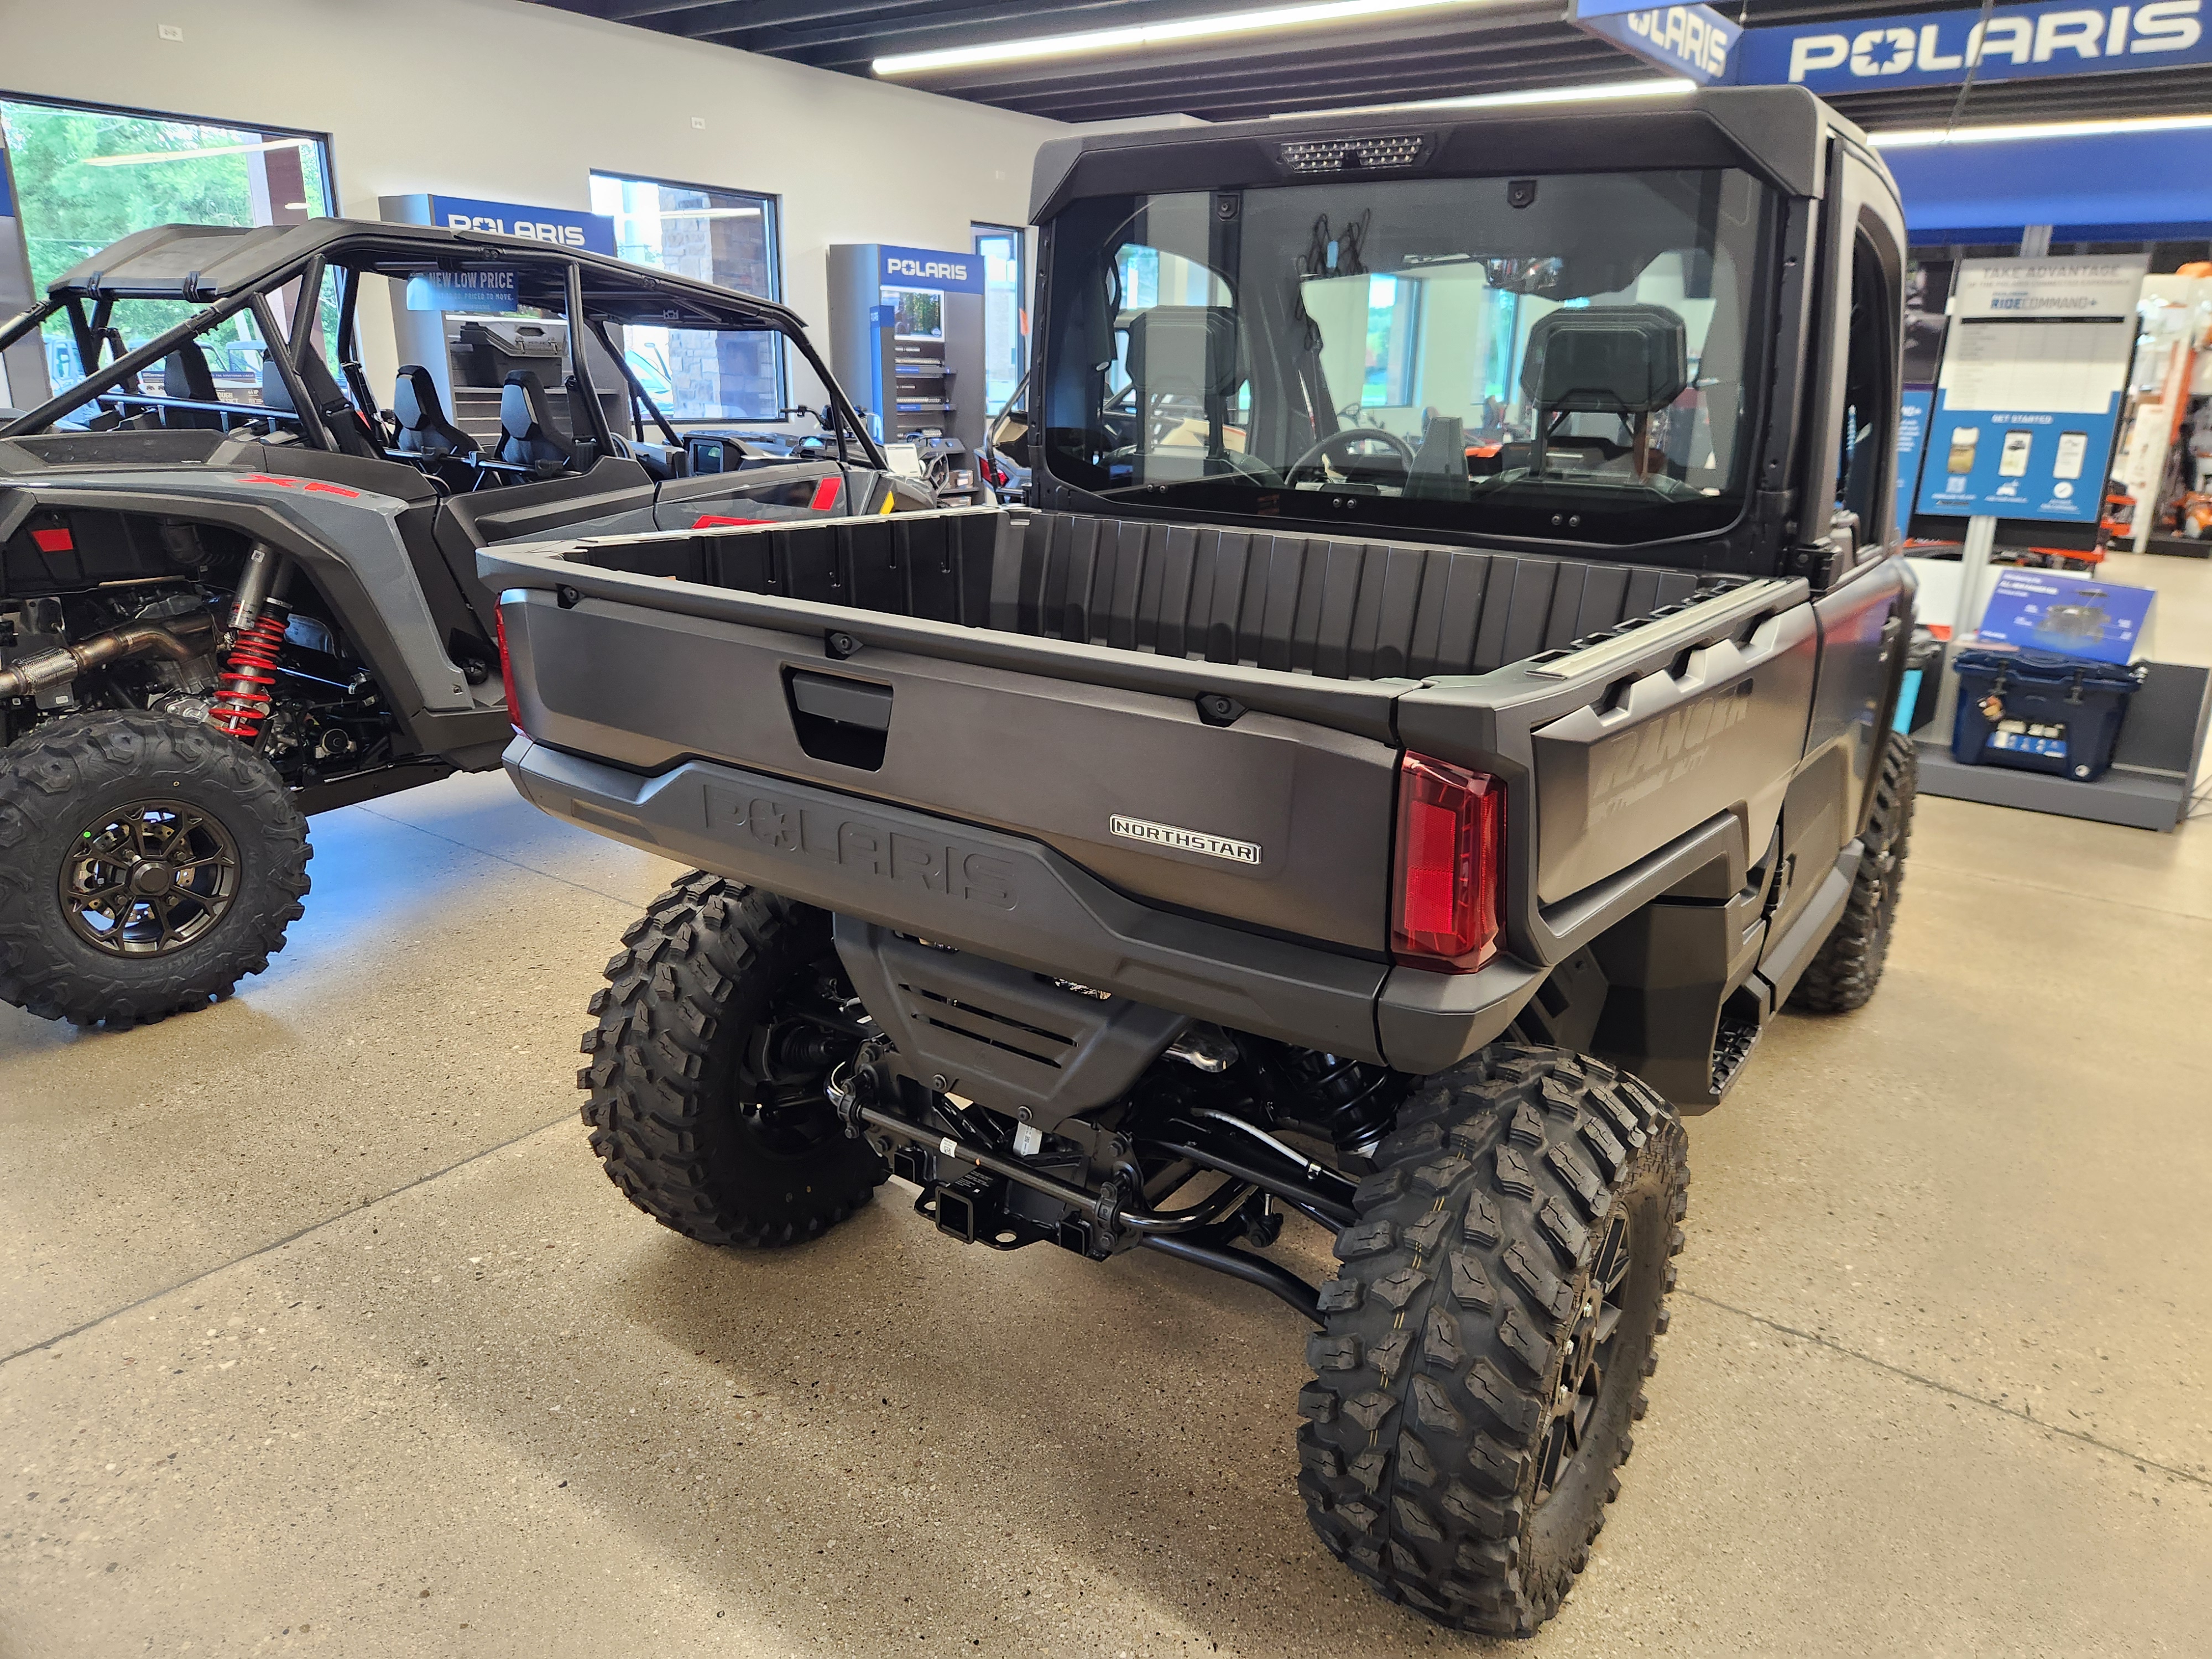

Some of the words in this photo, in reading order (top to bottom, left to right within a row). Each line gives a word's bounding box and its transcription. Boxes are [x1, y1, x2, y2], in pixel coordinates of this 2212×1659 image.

[1627, 7, 1727, 77] OLARIS
[1788, 1, 2203, 83] POLARIS
[448, 213, 586, 246] POLARIS
[429, 272, 451, 288] NEW
[455, 273, 477, 289] LOW
[480, 272, 514, 289] PRICE
[887, 258, 968, 280] POLARIS
[1983, 267, 2022, 278] TAKE
[703, 784, 1018, 911] POLARIS
[1116, 821, 1251, 859] NORTHSTAR
